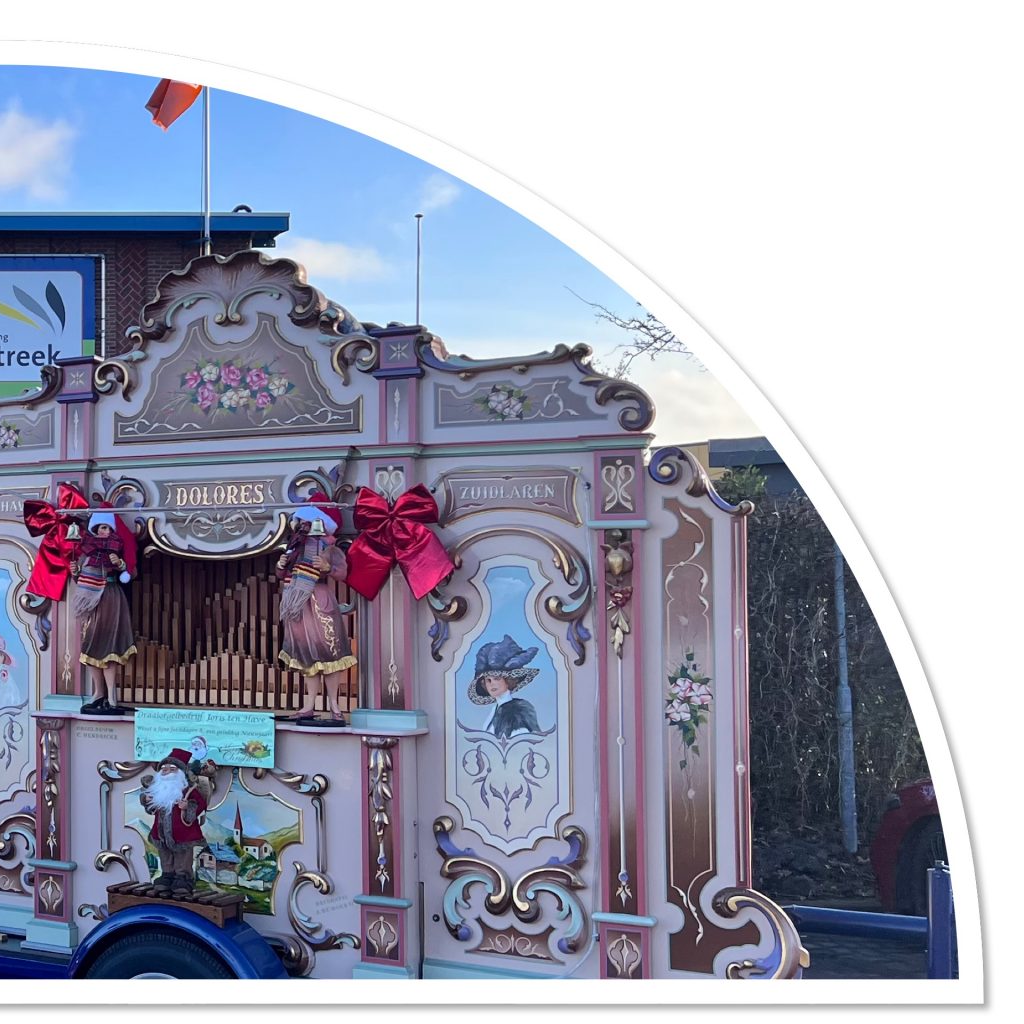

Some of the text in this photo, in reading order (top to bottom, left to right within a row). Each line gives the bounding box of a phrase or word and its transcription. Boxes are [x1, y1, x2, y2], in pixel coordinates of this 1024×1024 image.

[176, 484, 264, 506] DOLORES
[459, 483, 555, 500] ZUIDLAREN
[1, 500, 25, 512] HAV
